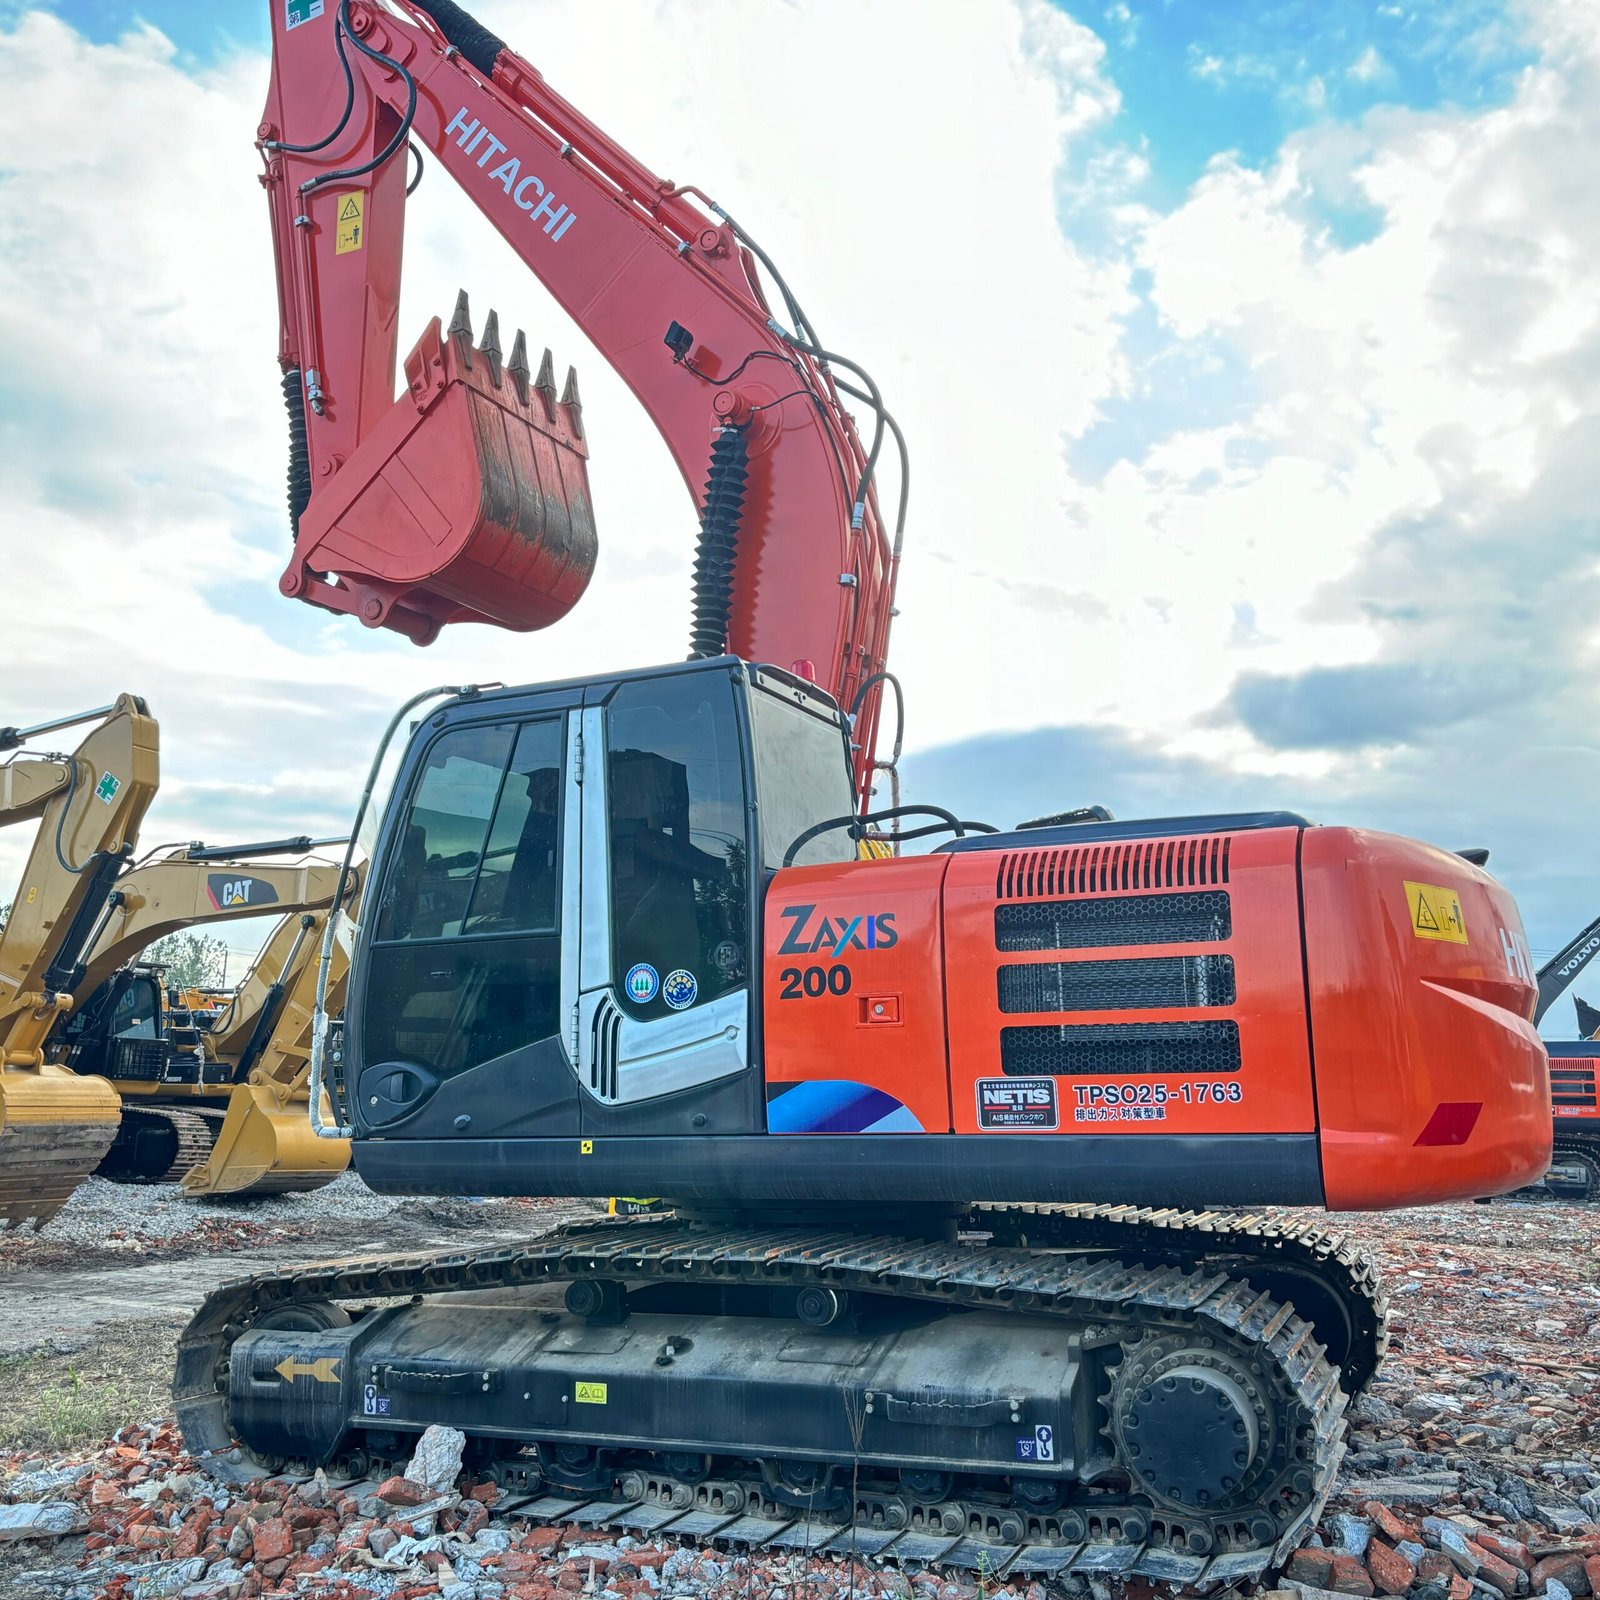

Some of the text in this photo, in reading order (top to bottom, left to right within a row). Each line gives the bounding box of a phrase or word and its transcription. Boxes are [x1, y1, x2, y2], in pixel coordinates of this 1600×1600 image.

[444, 106, 577, 243] HITACHI
[223, 880, 252, 906] CAT
[777, 904, 899, 958] ZAXIS
[1557, 937, 1600, 976] VOLVO
[780, 963, 852, 1000] 200
[983, 1088, 1051, 1105] NETIS
